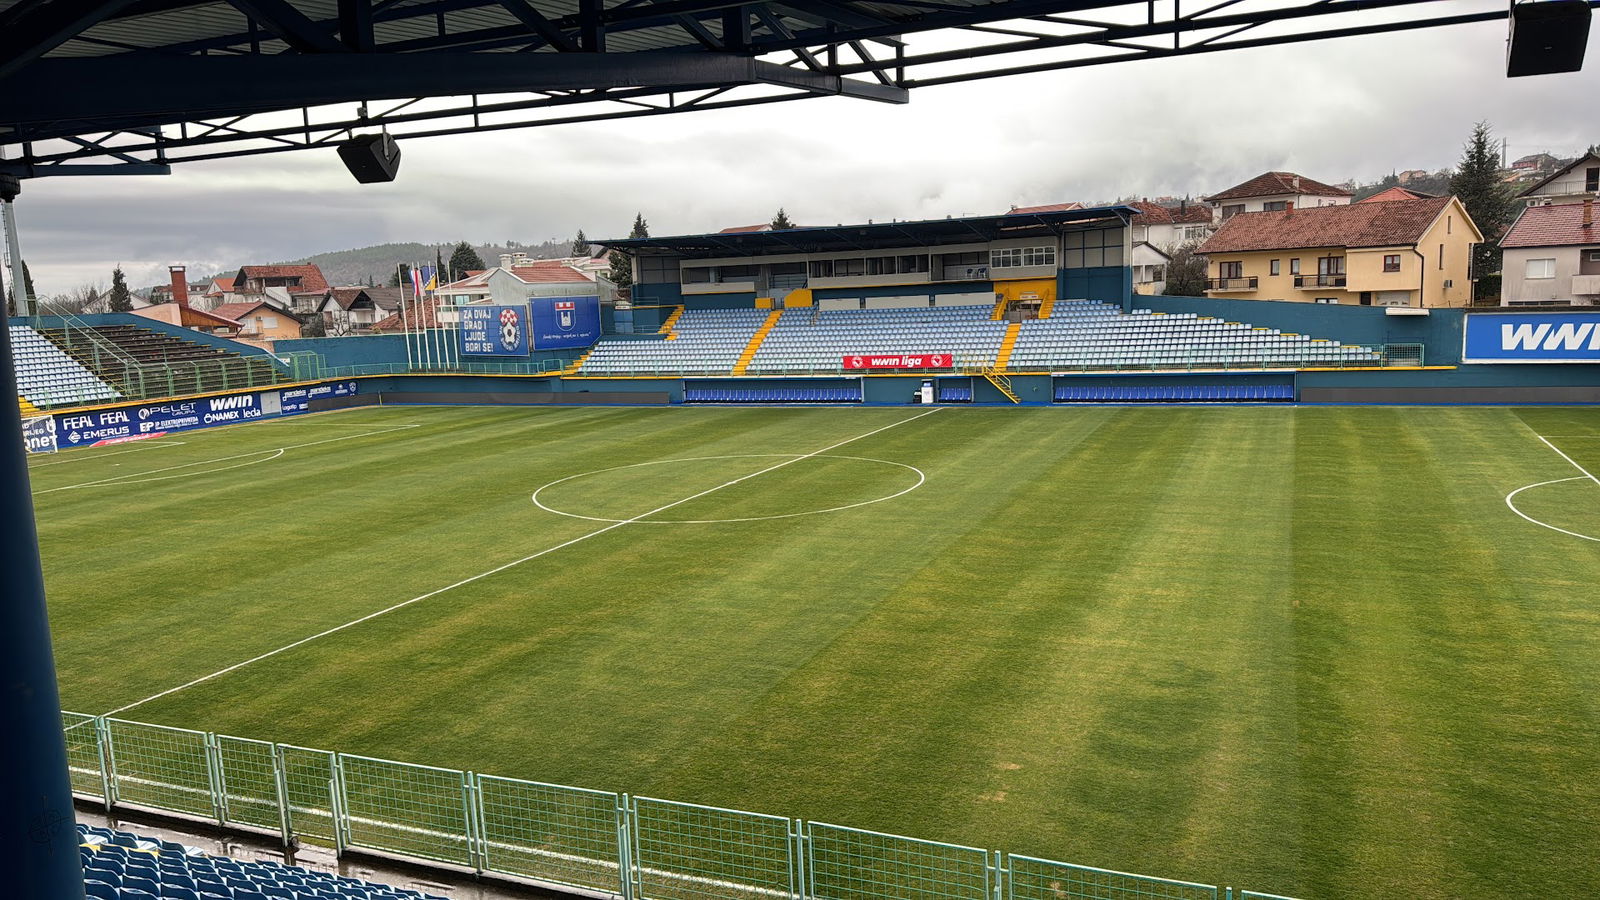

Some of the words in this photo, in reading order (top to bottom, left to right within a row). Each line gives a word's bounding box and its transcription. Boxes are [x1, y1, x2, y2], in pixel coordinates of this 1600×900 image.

[464, 310, 474, 319] ZA
[474, 310, 492, 319] OVAJ
[464, 321, 482, 330] GRAD
[464, 332, 486, 340] LJUDE
[466, 343, 481, 352] BORI
[482, 343, 494, 352] SE!
[901, 356, 922, 367] liga
[150, 402, 196, 415] PELET
[243, 407, 261, 418] leda
[63, 416, 95, 430] FEAL
[100, 411, 130, 425] FEAL
[212, 410, 240, 422] NAMEX
[140, 421, 154, 432] EP
[83, 426, 130, 440] EMERUS
